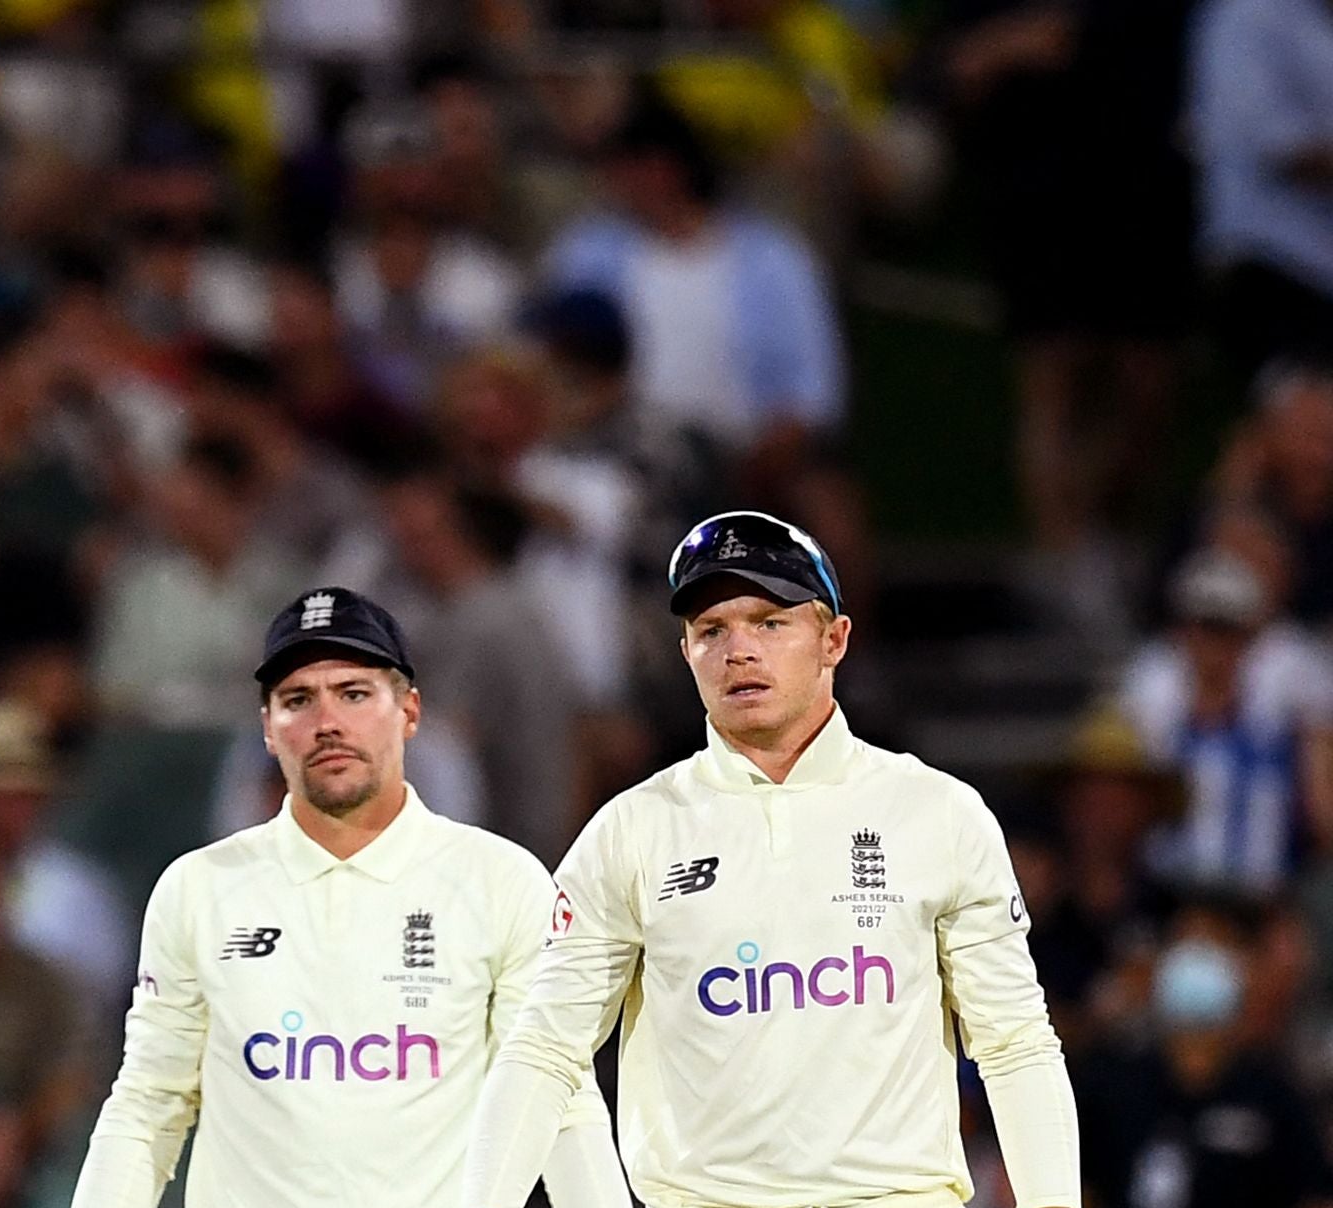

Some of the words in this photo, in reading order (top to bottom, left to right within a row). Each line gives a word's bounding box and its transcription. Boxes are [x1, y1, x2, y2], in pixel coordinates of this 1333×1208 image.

[832, 893, 867, 903] ASHES
[868, 892, 905, 904] SERIES
[851, 904, 887, 914] 2021/22
[857, 915, 883, 929] 687
[697, 940, 895, 1017] cinch
[243, 1010, 441, 1081] cinch
